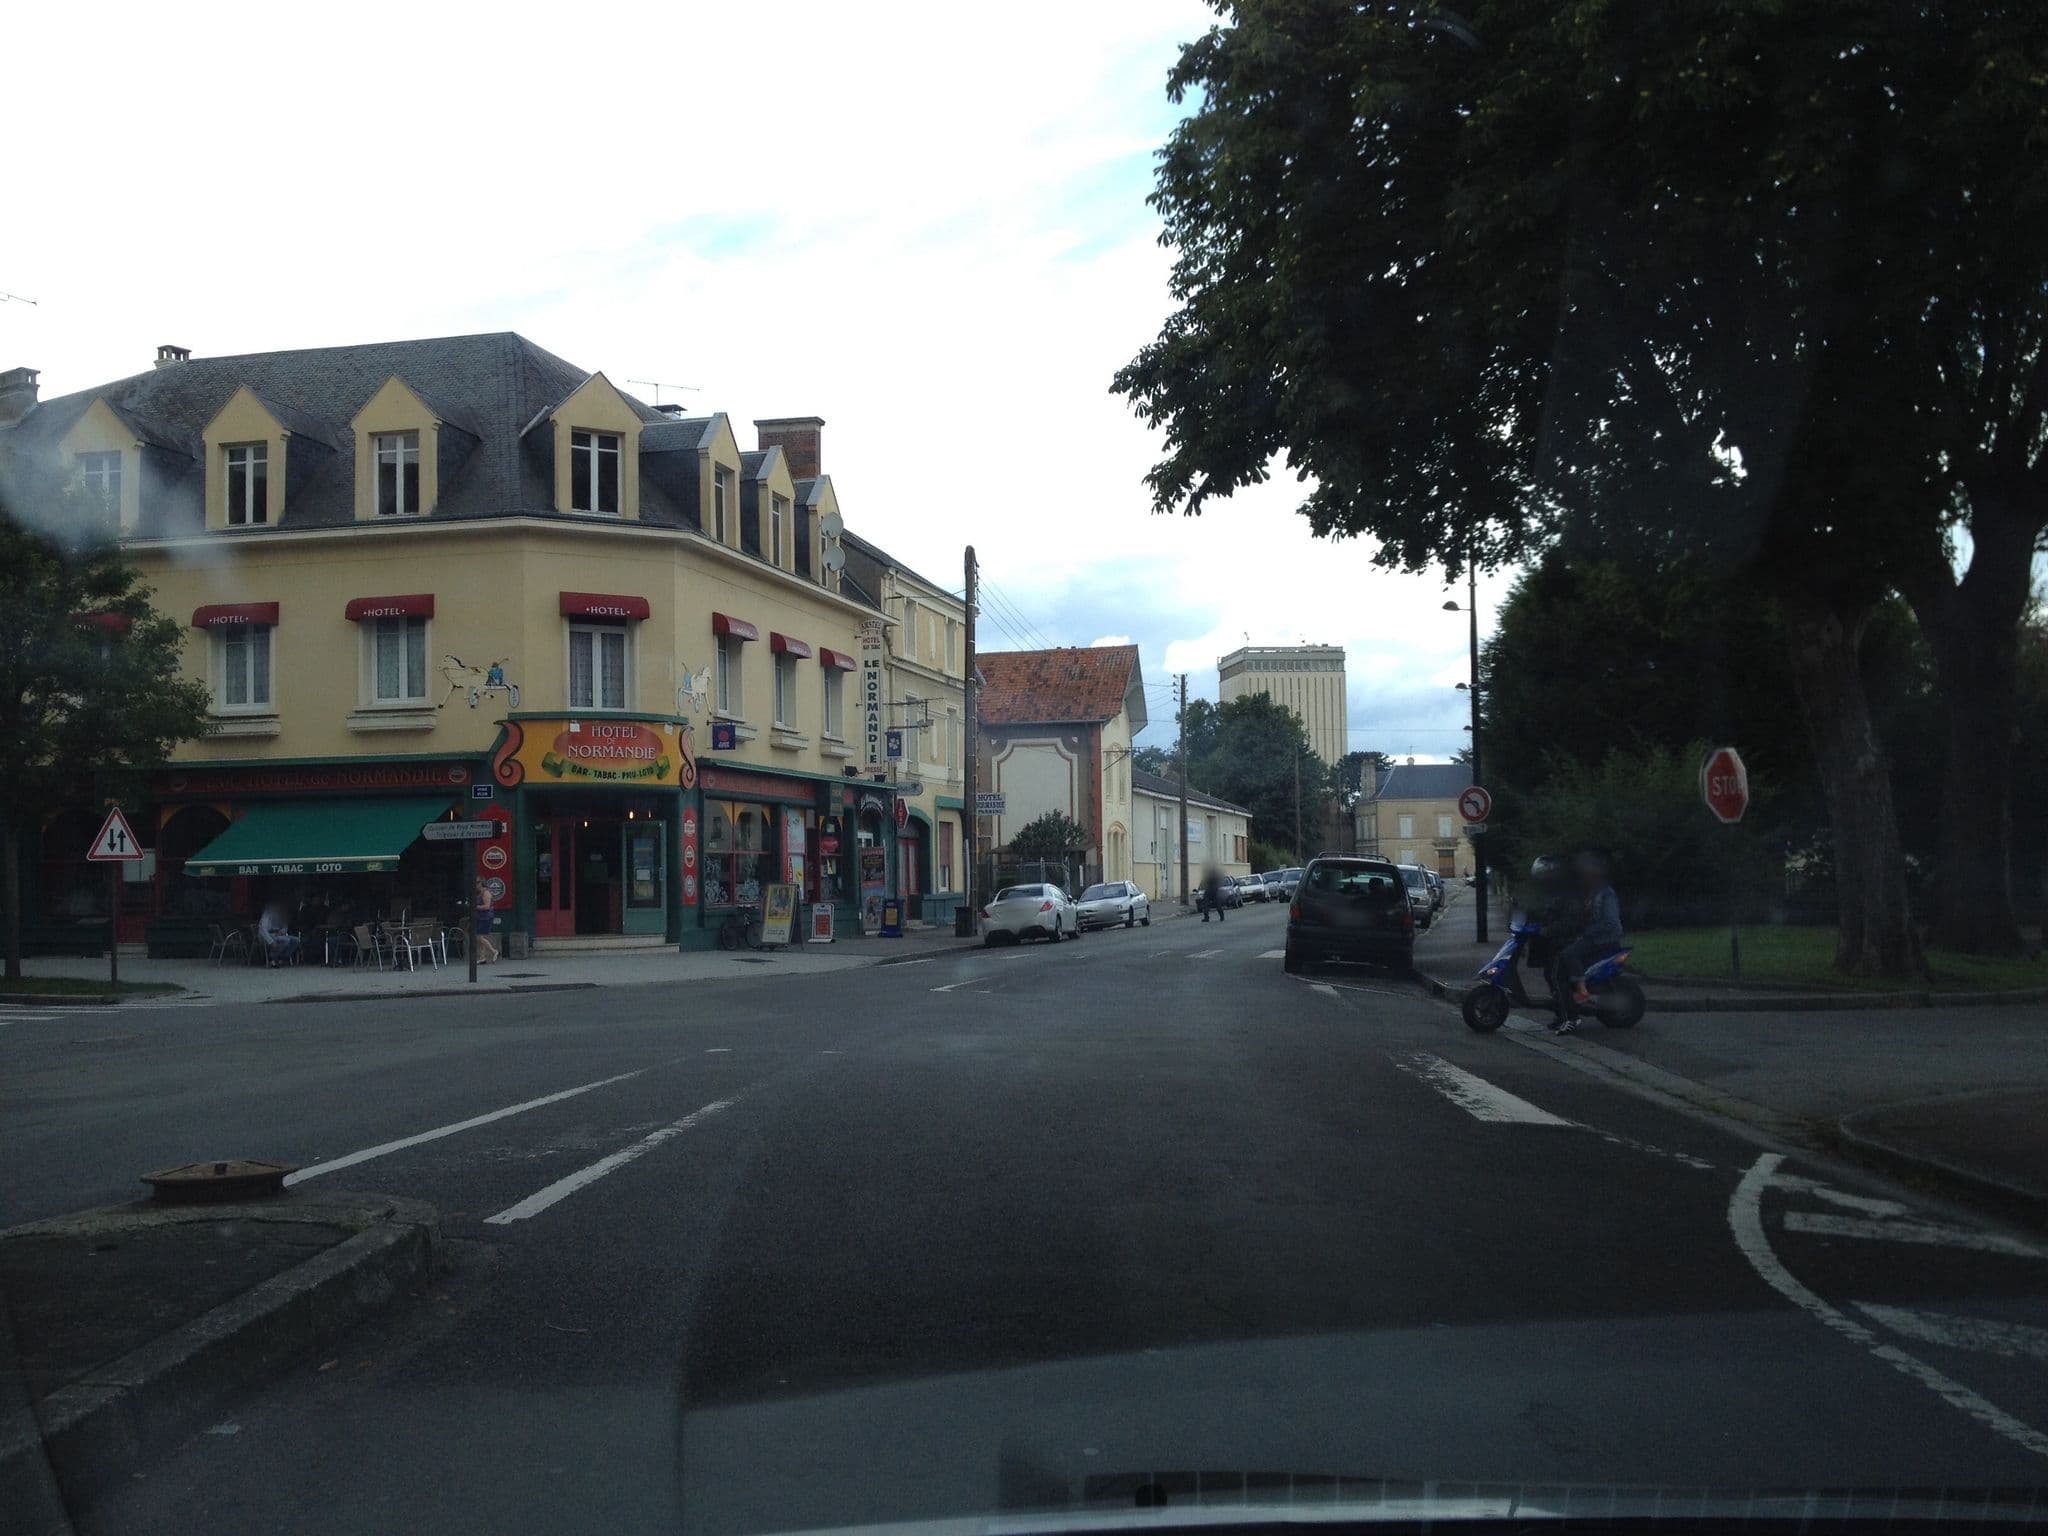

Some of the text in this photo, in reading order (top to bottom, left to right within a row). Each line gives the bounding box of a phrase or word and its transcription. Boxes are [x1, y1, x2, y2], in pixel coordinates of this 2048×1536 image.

[367, 607, 401, 617] HOTEL
[590, 606, 627, 616] HOTEL
[213, 615, 245, 625] HOTEL
[864, 660, 880, 668] LE
[867, 671, 879, 763] NORMANDIE
[591, 726, 637, 739] HOTEL
[567, 745, 657, 760] NORMANDIE
[571, 765, 589, 776] BAR
[594, 769, 617, 780] TABAC
[239, 862, 343, 875] BAR TABAC LOTO
